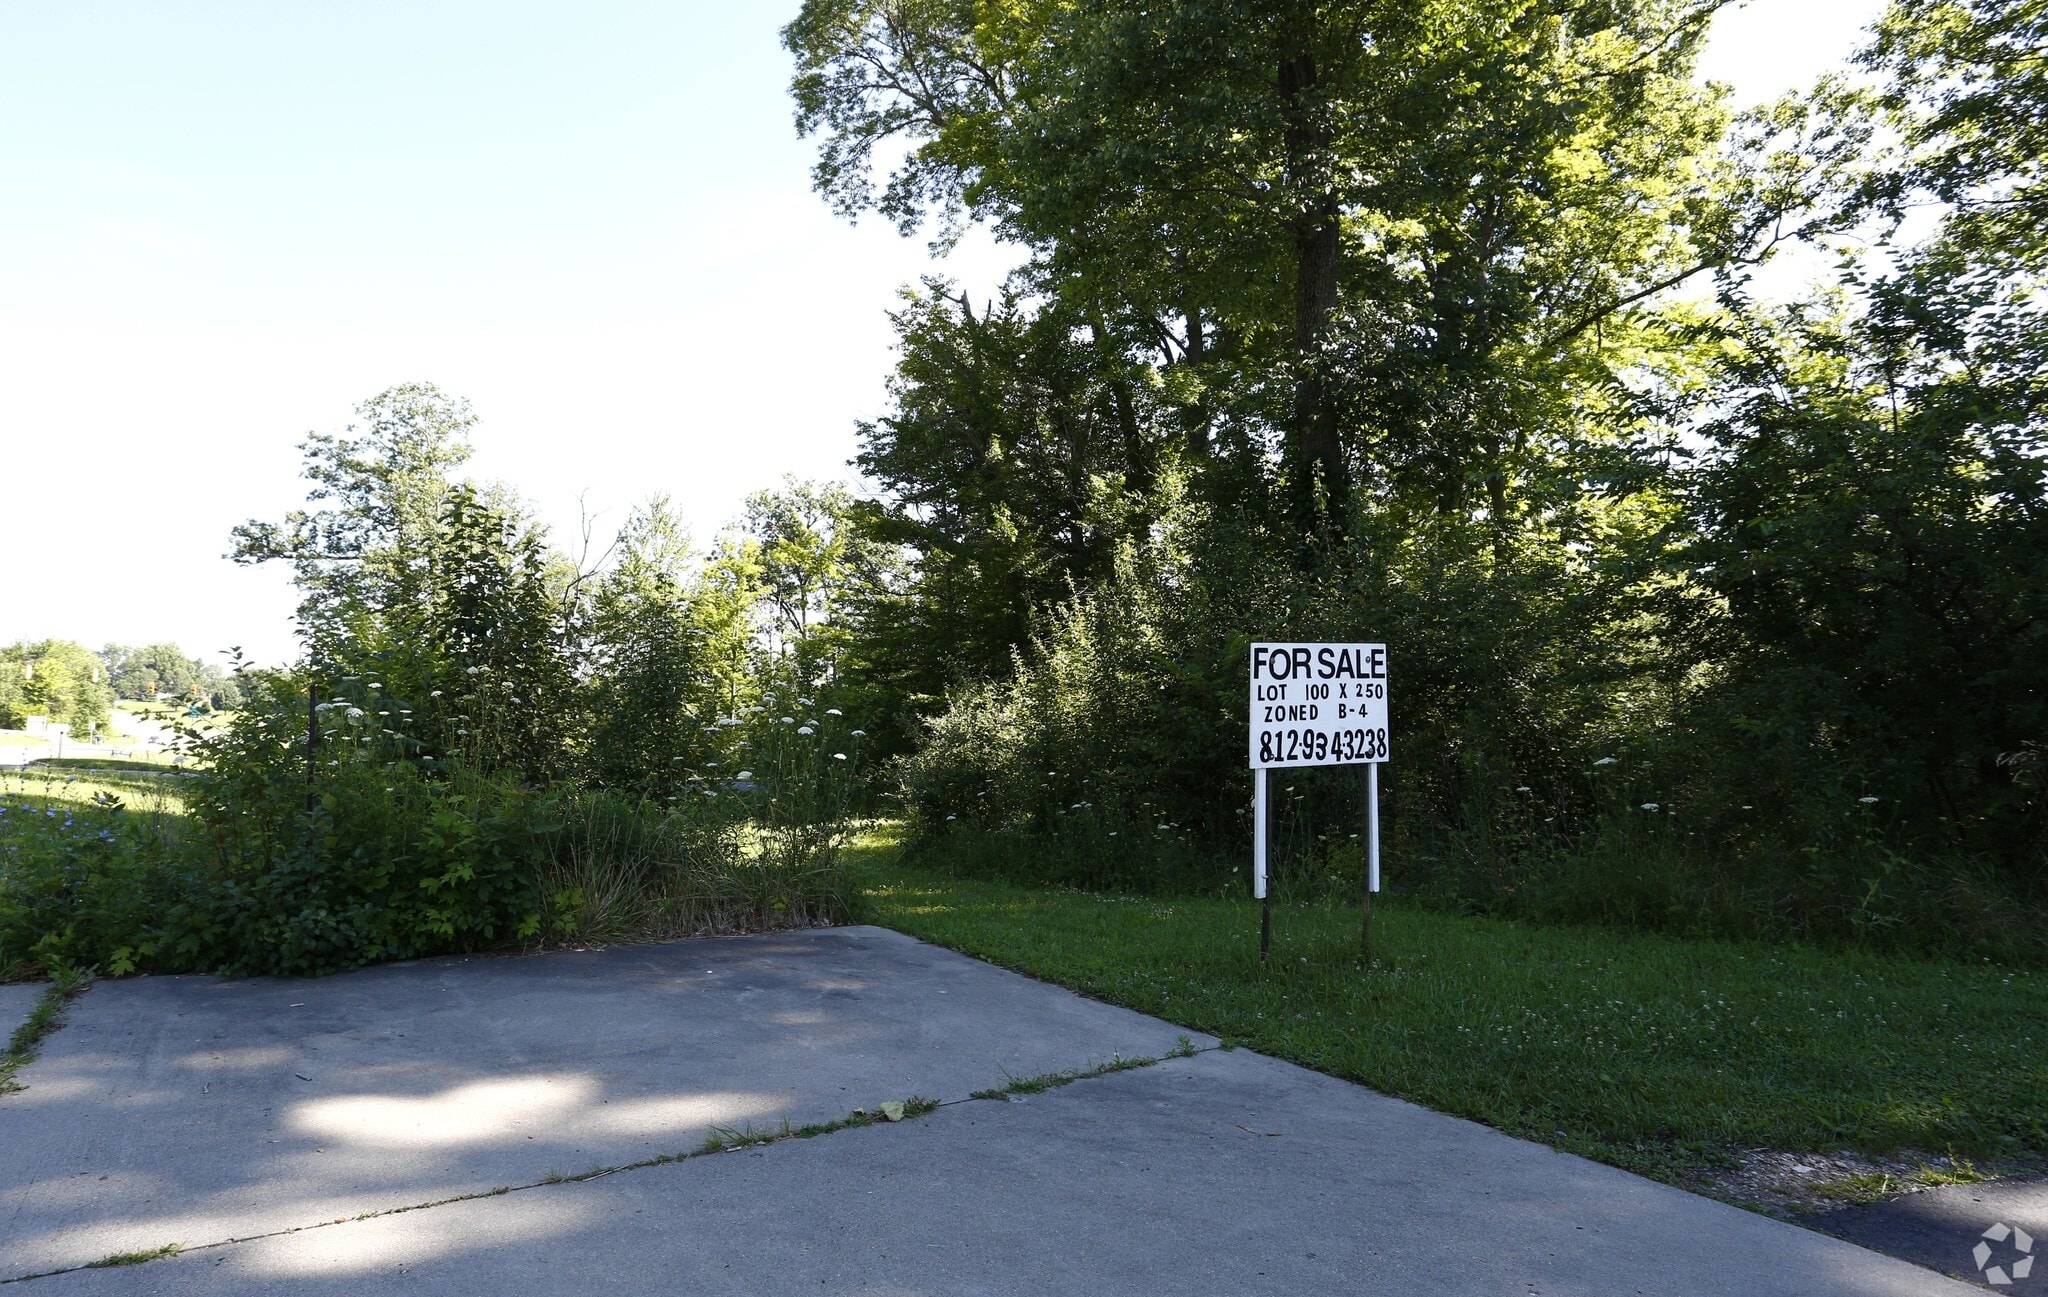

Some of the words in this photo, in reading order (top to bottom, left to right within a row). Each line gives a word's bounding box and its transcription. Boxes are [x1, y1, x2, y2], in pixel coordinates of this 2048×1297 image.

[1253, 647, 1312, 680] FOR
[1317, 647, 1386, 680] SALE
[1257, 684, 1287, 701] LOT
[1305, 683, 1329, 701] 100
[1339, 683, 1348, 699] X
[1356, 683, 1383, 699] 250
[1264, 704, 1319, 723] ZONED
[1338, 703, 1368, 719] B-4
